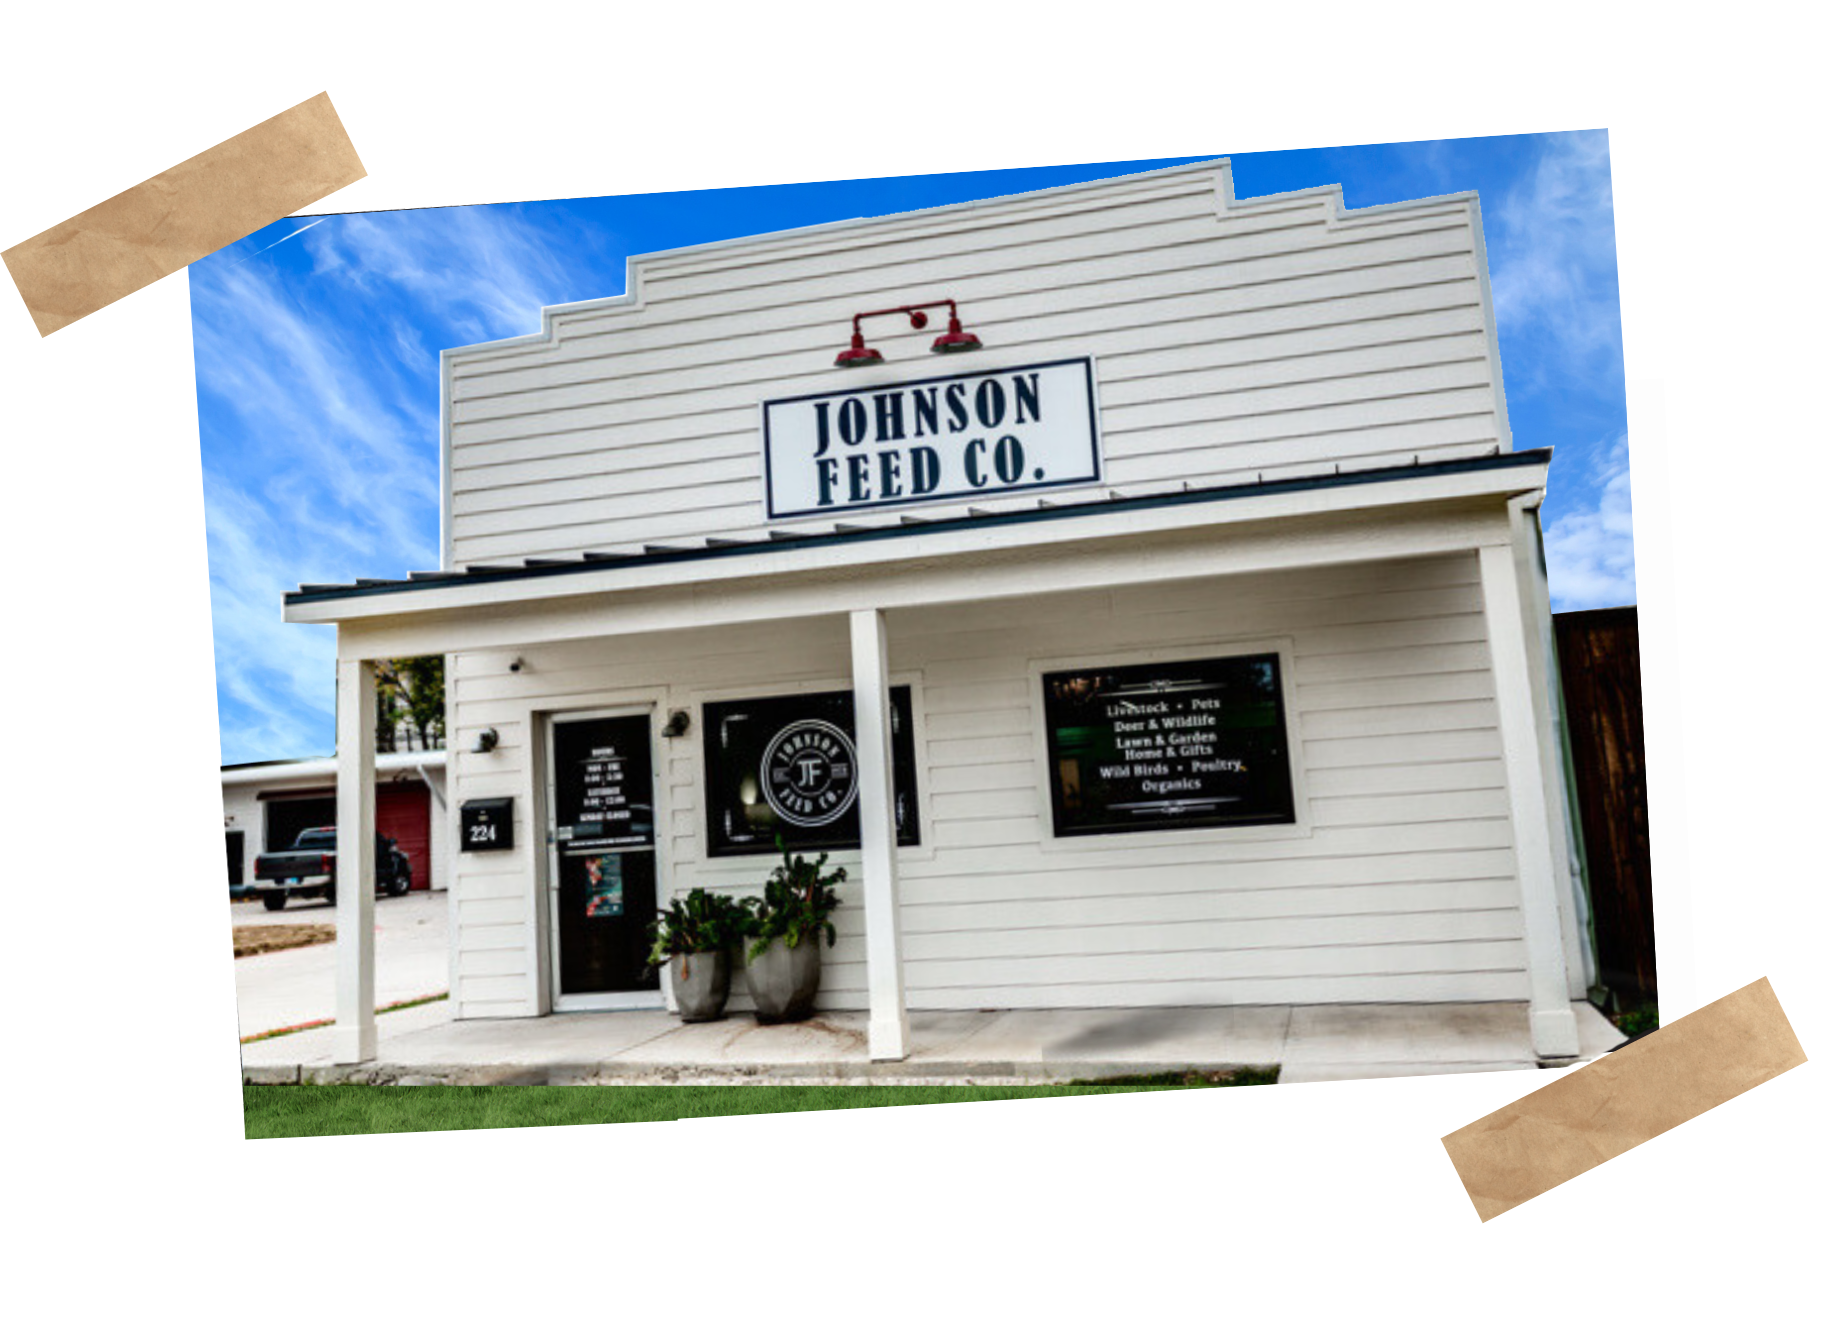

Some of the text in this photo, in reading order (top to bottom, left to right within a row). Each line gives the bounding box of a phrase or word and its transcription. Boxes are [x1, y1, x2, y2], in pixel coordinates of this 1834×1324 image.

[813, 373, 1040, 457] JOHNSON
[816, 434, 1044, 506] FEED CO.
[1106, 698, 1220, 717] Livestock Pets
[1114, 713, 1216, 732] Deer & Wildlife
[1116, 731, 1217, 749] Lawn & Garden
[1125, 744, 1213, 760] Home & Gifts
[797, 758, 823, 787] JF
[1100, 758, 1242, 778] Wild Birds Poultry
[1141, 777, 1202, 794] Organics
[469, 824, 496, 842] 224
